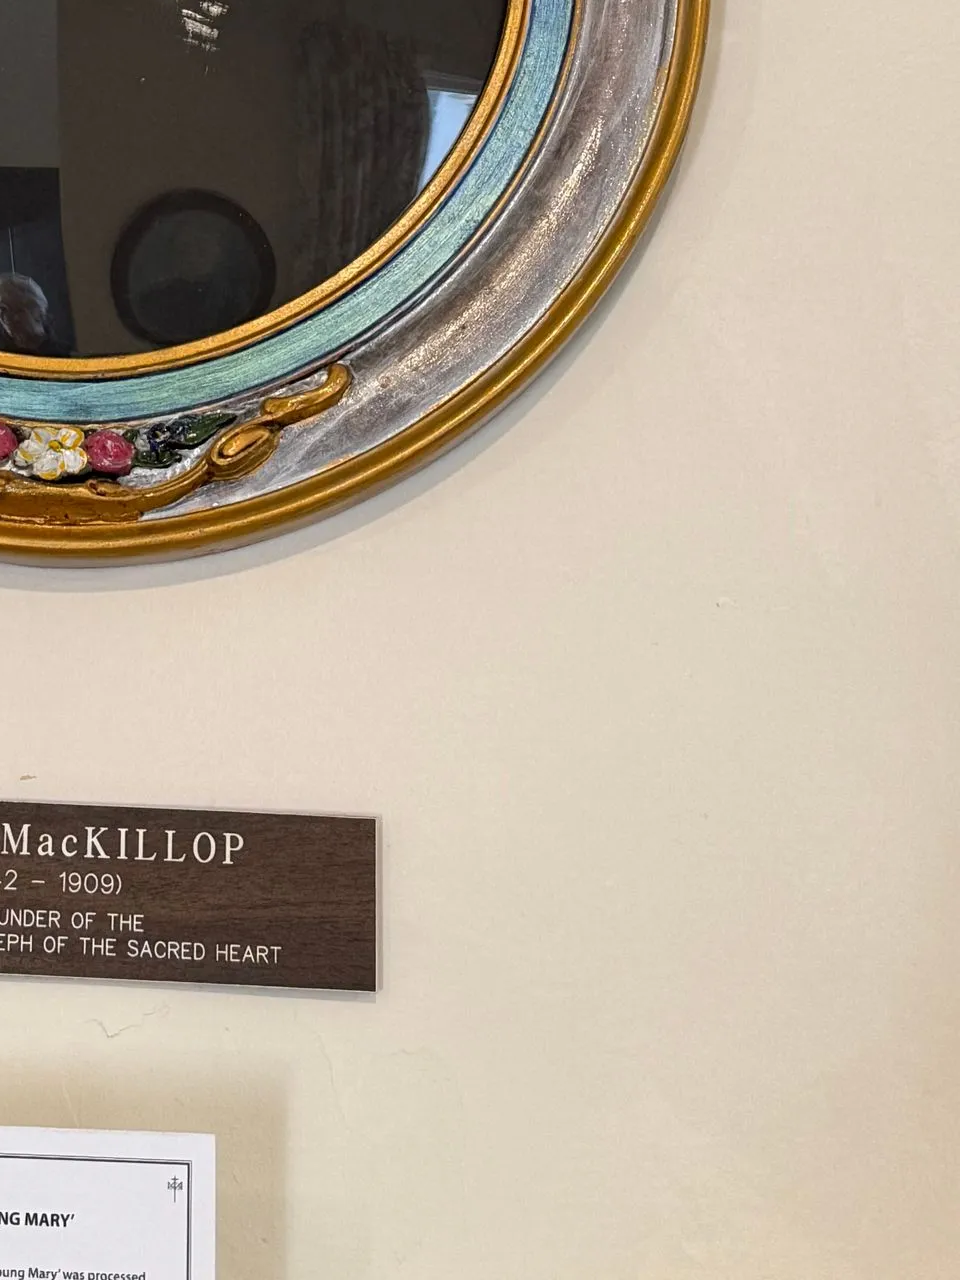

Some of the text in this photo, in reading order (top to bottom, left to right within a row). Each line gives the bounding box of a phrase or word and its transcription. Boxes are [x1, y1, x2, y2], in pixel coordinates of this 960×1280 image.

[0, 822, 244, 865] MacKILLOP
[59, 871, 122, 895] 1909)
[71, 911, 97, 930] OF
[106, 912, 145, 933] THE
[43, 935, 69, 954] OF
[79, 936, 117, 957] THE
[127, 939, 206, 961] SACRED
[216, 943, 282, 964] HEART
[62, 1271, 85, 1280] was
[87, 1271, 146, 1280] processed
